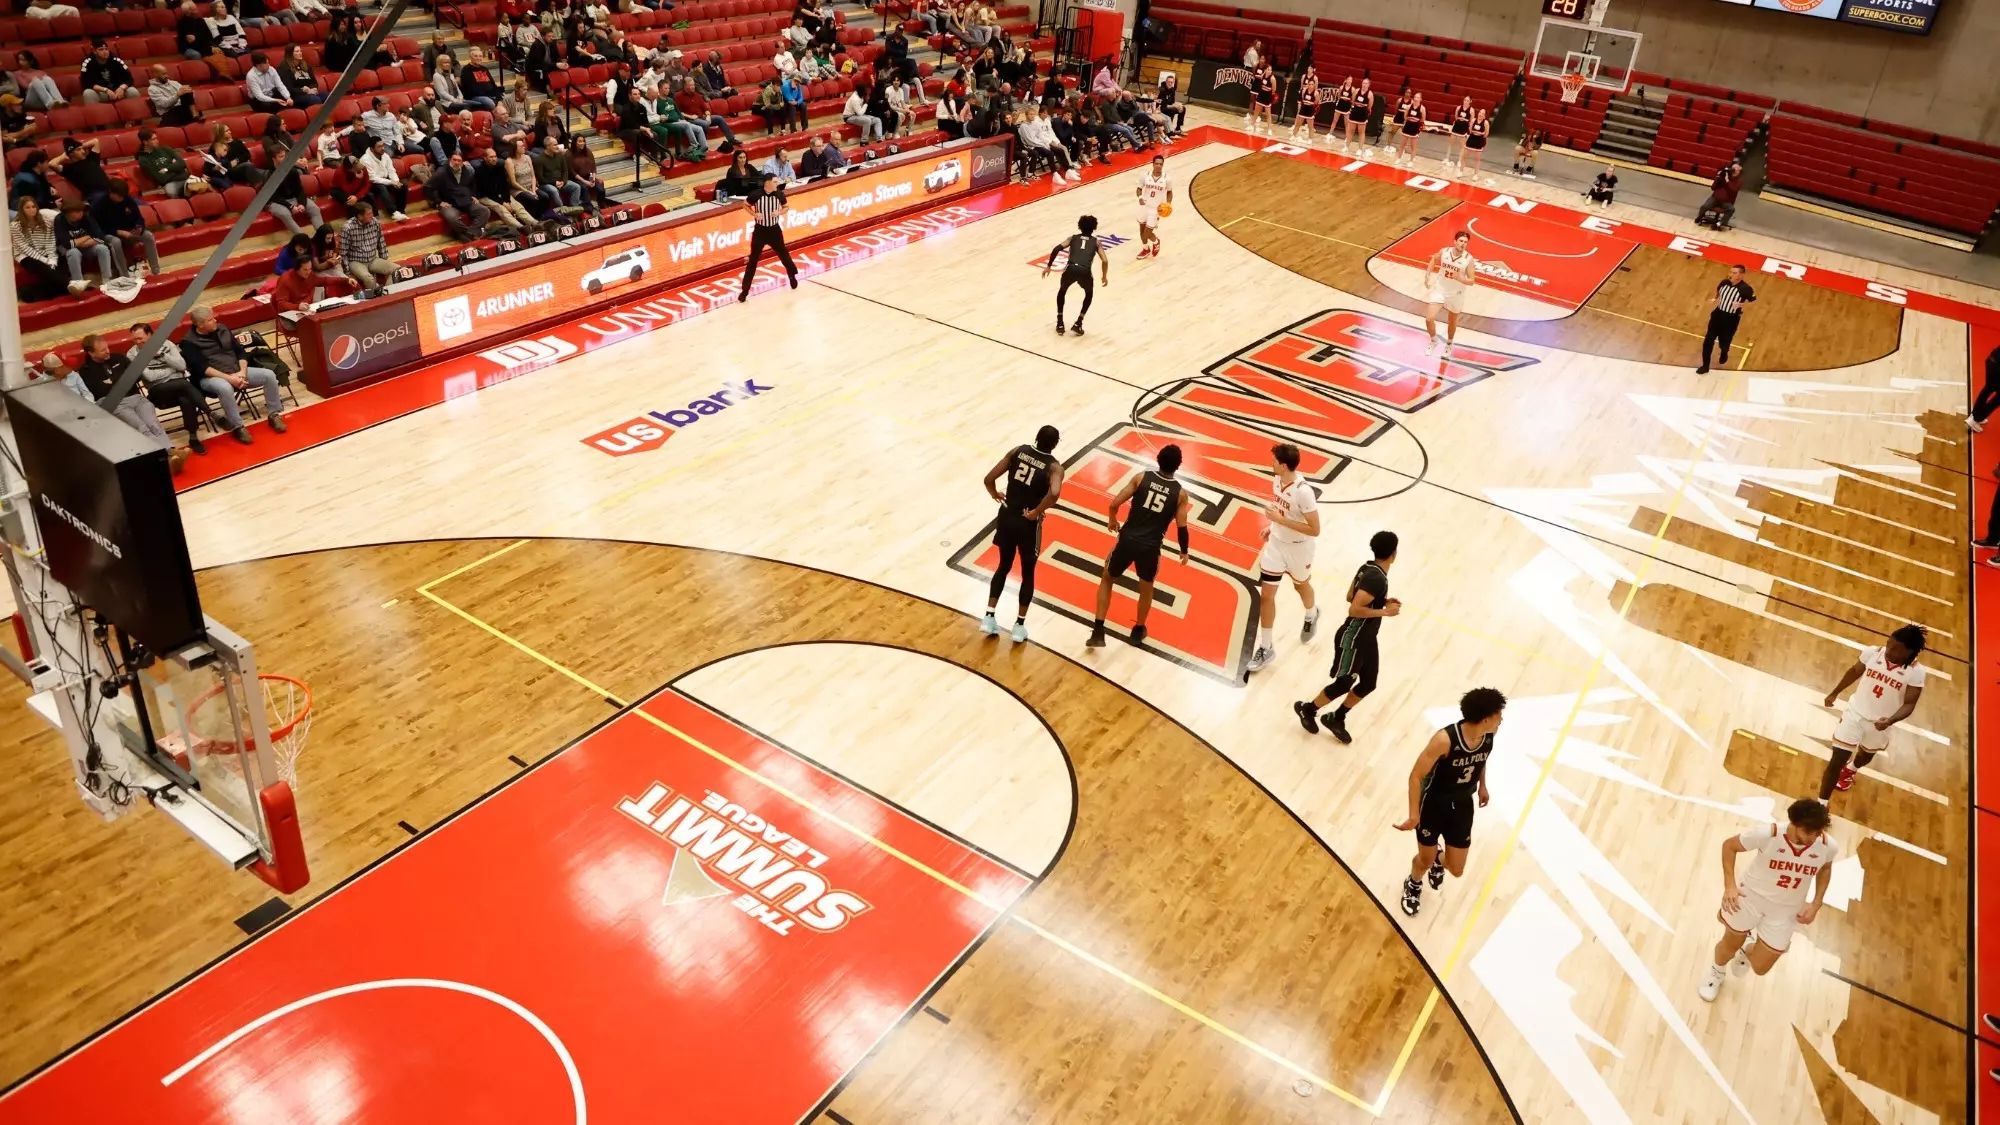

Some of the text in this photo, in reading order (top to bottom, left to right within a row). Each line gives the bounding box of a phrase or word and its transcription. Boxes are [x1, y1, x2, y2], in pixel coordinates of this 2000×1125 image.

[1551, 0, 1577, 14] 28
[1869, 0, 1914, 10] SPORTS
[1848, 7, 1926, 27] SUPERBOOK.COM
[1214, 67, 1254, 90] DENVE
[985, 156, 1006, 171] pepsi
[669, 239, 704, 263] Visit
[707, 227, 743, 250] Your
[786, 203, 828, 229] Range
[831, 191, 872, 217] Toyota
[875, 180, 912, 203] Stores
[1080, 239, 1086, 250] 1
[475, 204, 983, 370] DU UNIVERSITY OF DENVER
[476, 282, 555, 318] 4RUNNER
[362, 322, 409, 352] pepsi
[594, 378, 775, 452] us bank
[1014, 462, 1036, 486] 21
[946, 308, 1541, 688] DENVER
[1150, 481, 1164, 493] PRICE
[1142, 491, 1167, 513] 15
[1273, 494, 1290, 511] ENVER
[41, 493, 122, 559] DAKTRONICS
[1866, 668, 1903, 691] DENVER
[1872, 684, 1884, 699] 4
[1452, 751, 1489, 767] CAL POLY
[1456, 765, 1475, 784] 3
[701, 789, 830, 868] LEAGUE
[616, 782, 871, 932] SUMMIT
[1768, 859, 1818, 876] DENVER
[1776, 874, 1802, 889] 21
[732, 893, 796, 936] THE
